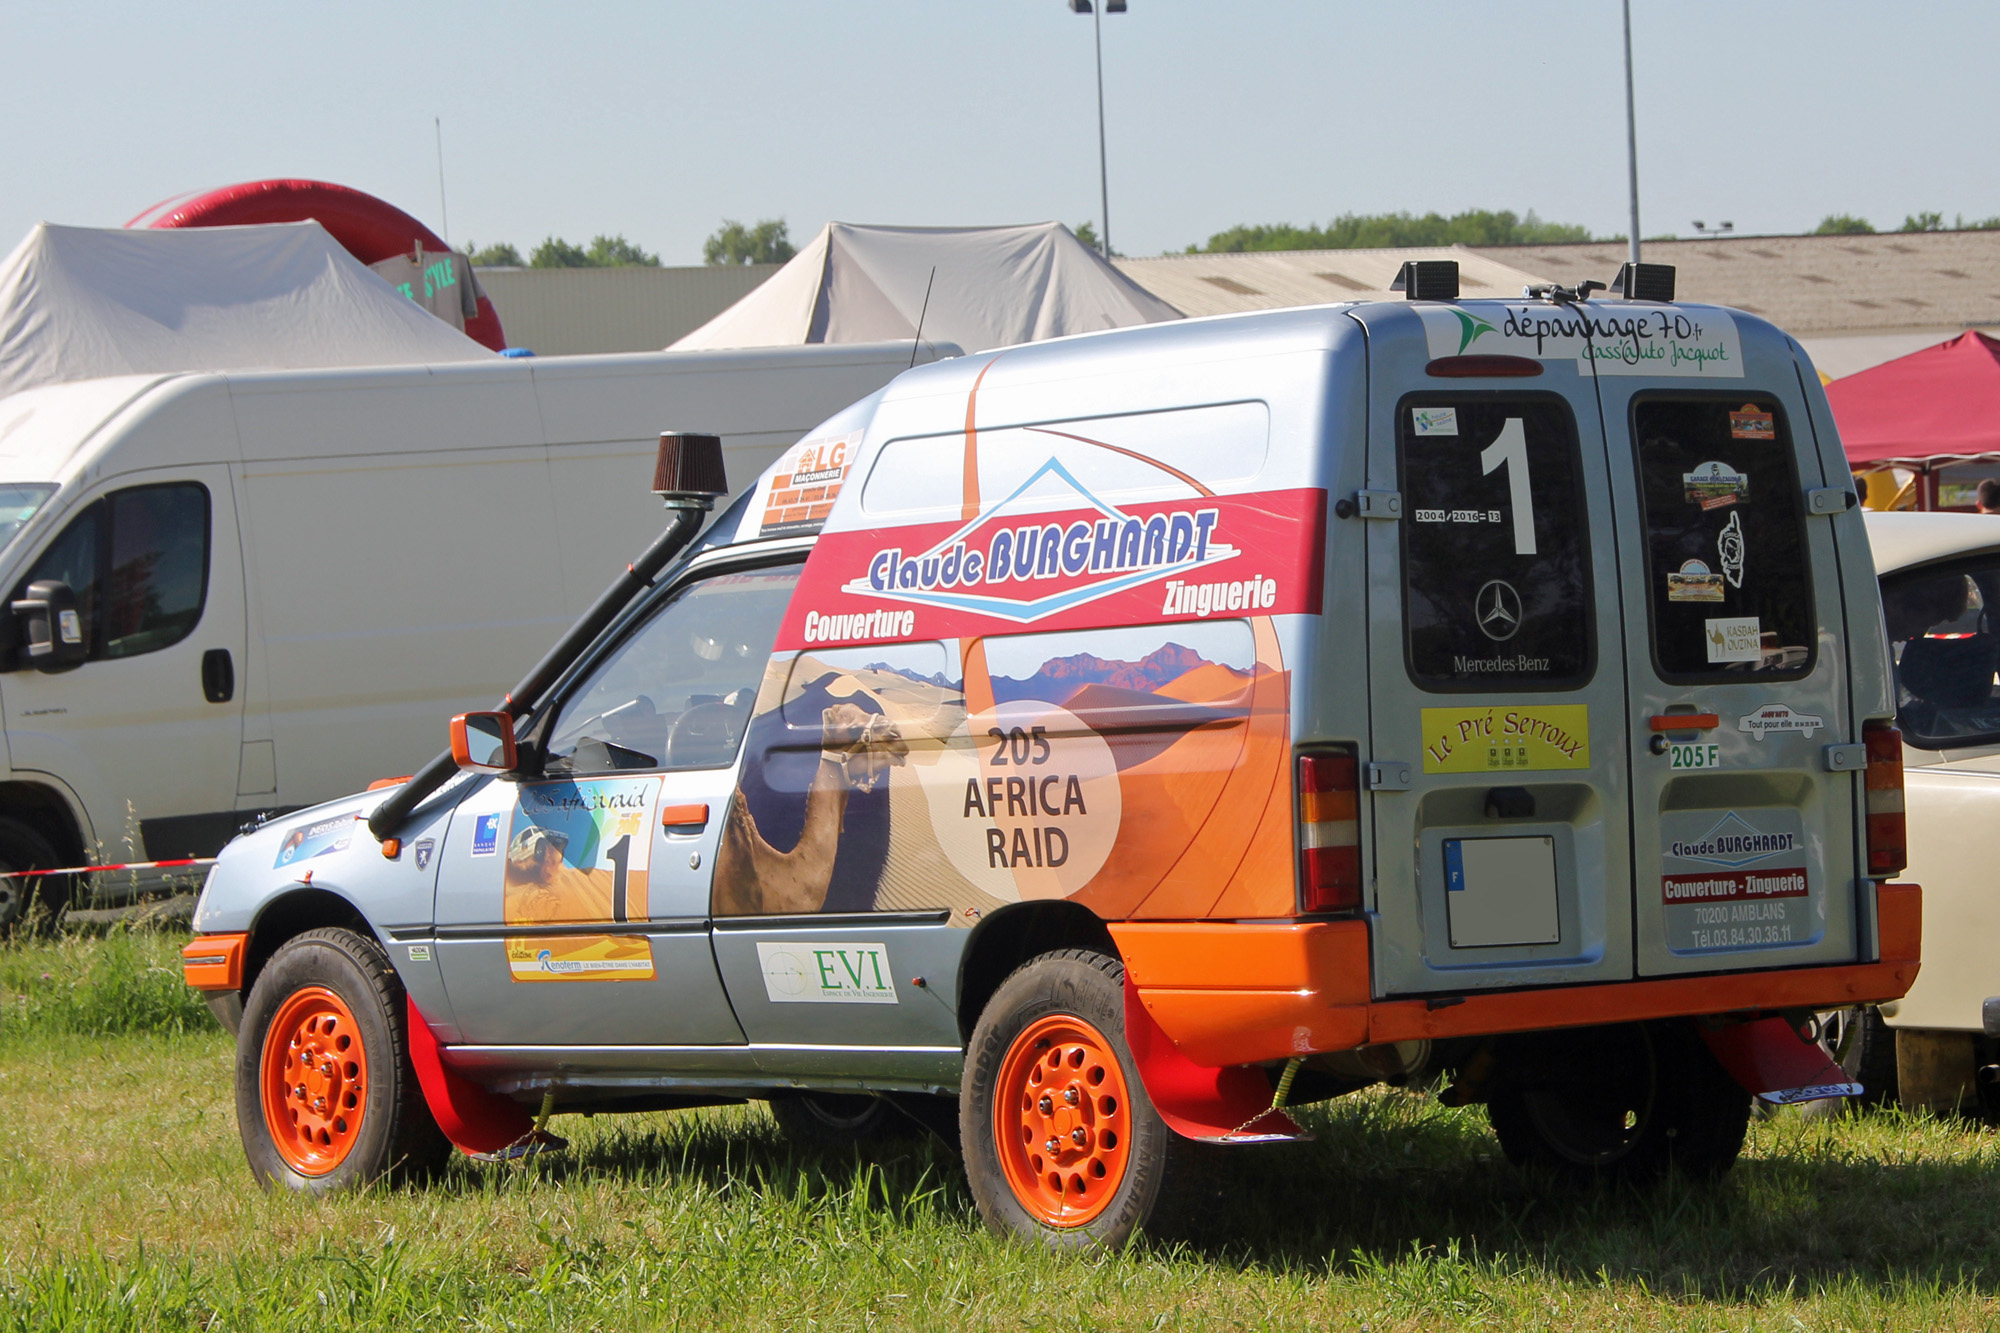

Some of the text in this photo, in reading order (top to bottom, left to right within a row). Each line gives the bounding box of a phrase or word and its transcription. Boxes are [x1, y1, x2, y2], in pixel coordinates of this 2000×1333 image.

[1669, 340, 1729, 371] Jacquot
[814, 441, 846, 471] LG
[794, 469, 840, 484] MAÇONNERIE
[1481, 417, 1536, 554] 1
[869, 510, 1218, 591] Claude BURGHARDT
[1162, 574, 1277, 616] Zinguerie
[804, 609, 915, 643] Couverture
[1727, 624, 1759, 637] KASBAH
[1454, 654, 1550, 673] Mercedes-Benz
[1427, 708, 1585, 765] Le Pré Serroux
[1748, 720, 1763, 729] Tout
[1764, 721, 1780, 730] pour
[1781, 719, 1793, 728] elle
[988, 726, 1051, 766] 205
[1671, 745, 1719, 767] 205 F
[963, 775, 1087, 818] AFRICA
[986, 827, 1069, 868] RAID
[1672, 833, 1794, 856] Claude BURGHARDT
[606, 834, 631, 924] 1
[1452, 871, 1458, 883] F
[1664, 879, 1737, 899] Couverture
[1745, 873, 1805, 895] Zinguerie
[1694, 902, 1786, 924] 70200 AMBLANS
